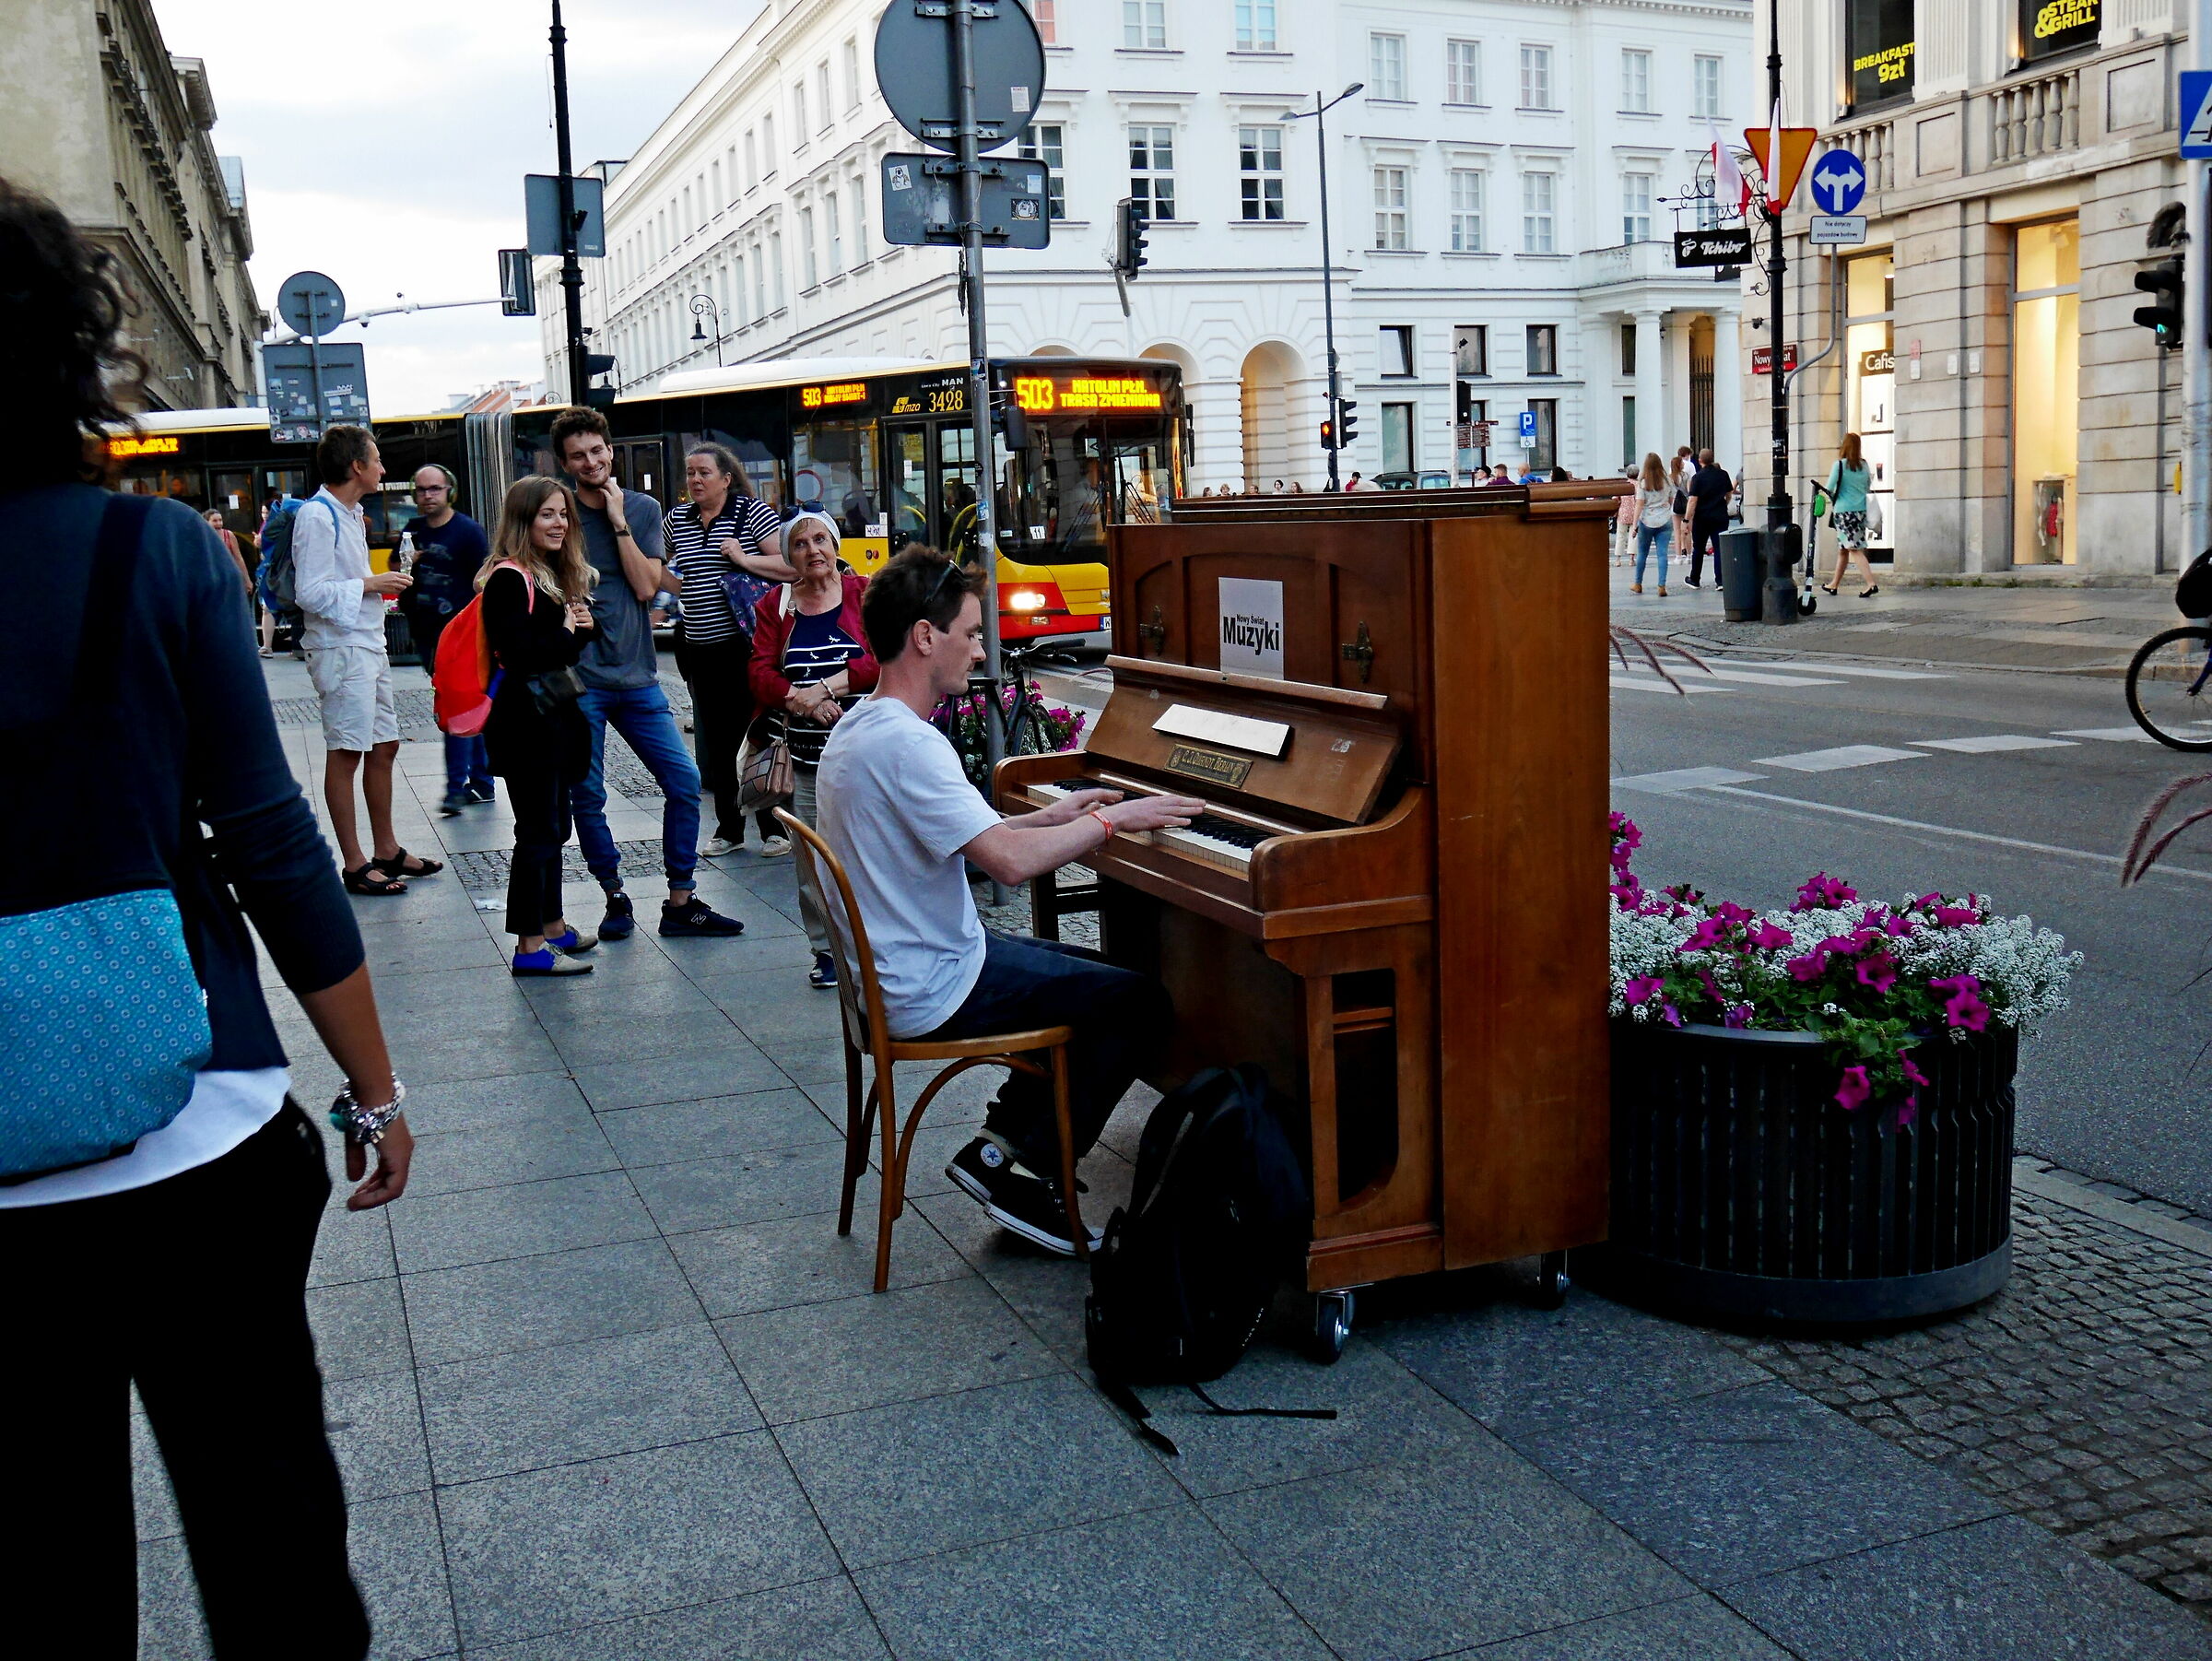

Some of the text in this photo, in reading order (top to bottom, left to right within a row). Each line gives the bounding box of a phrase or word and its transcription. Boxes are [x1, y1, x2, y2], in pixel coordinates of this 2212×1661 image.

[1853, 42, 1915, 72] BREAKFAST
[1700, 240, 1747, 255] Tchibo
[1754, 355, 1771, 367] Nowy
[941, 377, 964, 387] MAN
[803, 388, 821, 406] 503
[928, 390, 963, 413] 3428
[1017, 379, 1054, 409] 503
[1072, 380, 1121, 394] NATOLIN
[1060, 394, 1160, 407] TRASA ZMIENIONA
[1523, 413, 1533, 430] P
[1236, 613, 1265, 626] Nowy Świat
[1223, 616, 1280, 656] Muzyki
